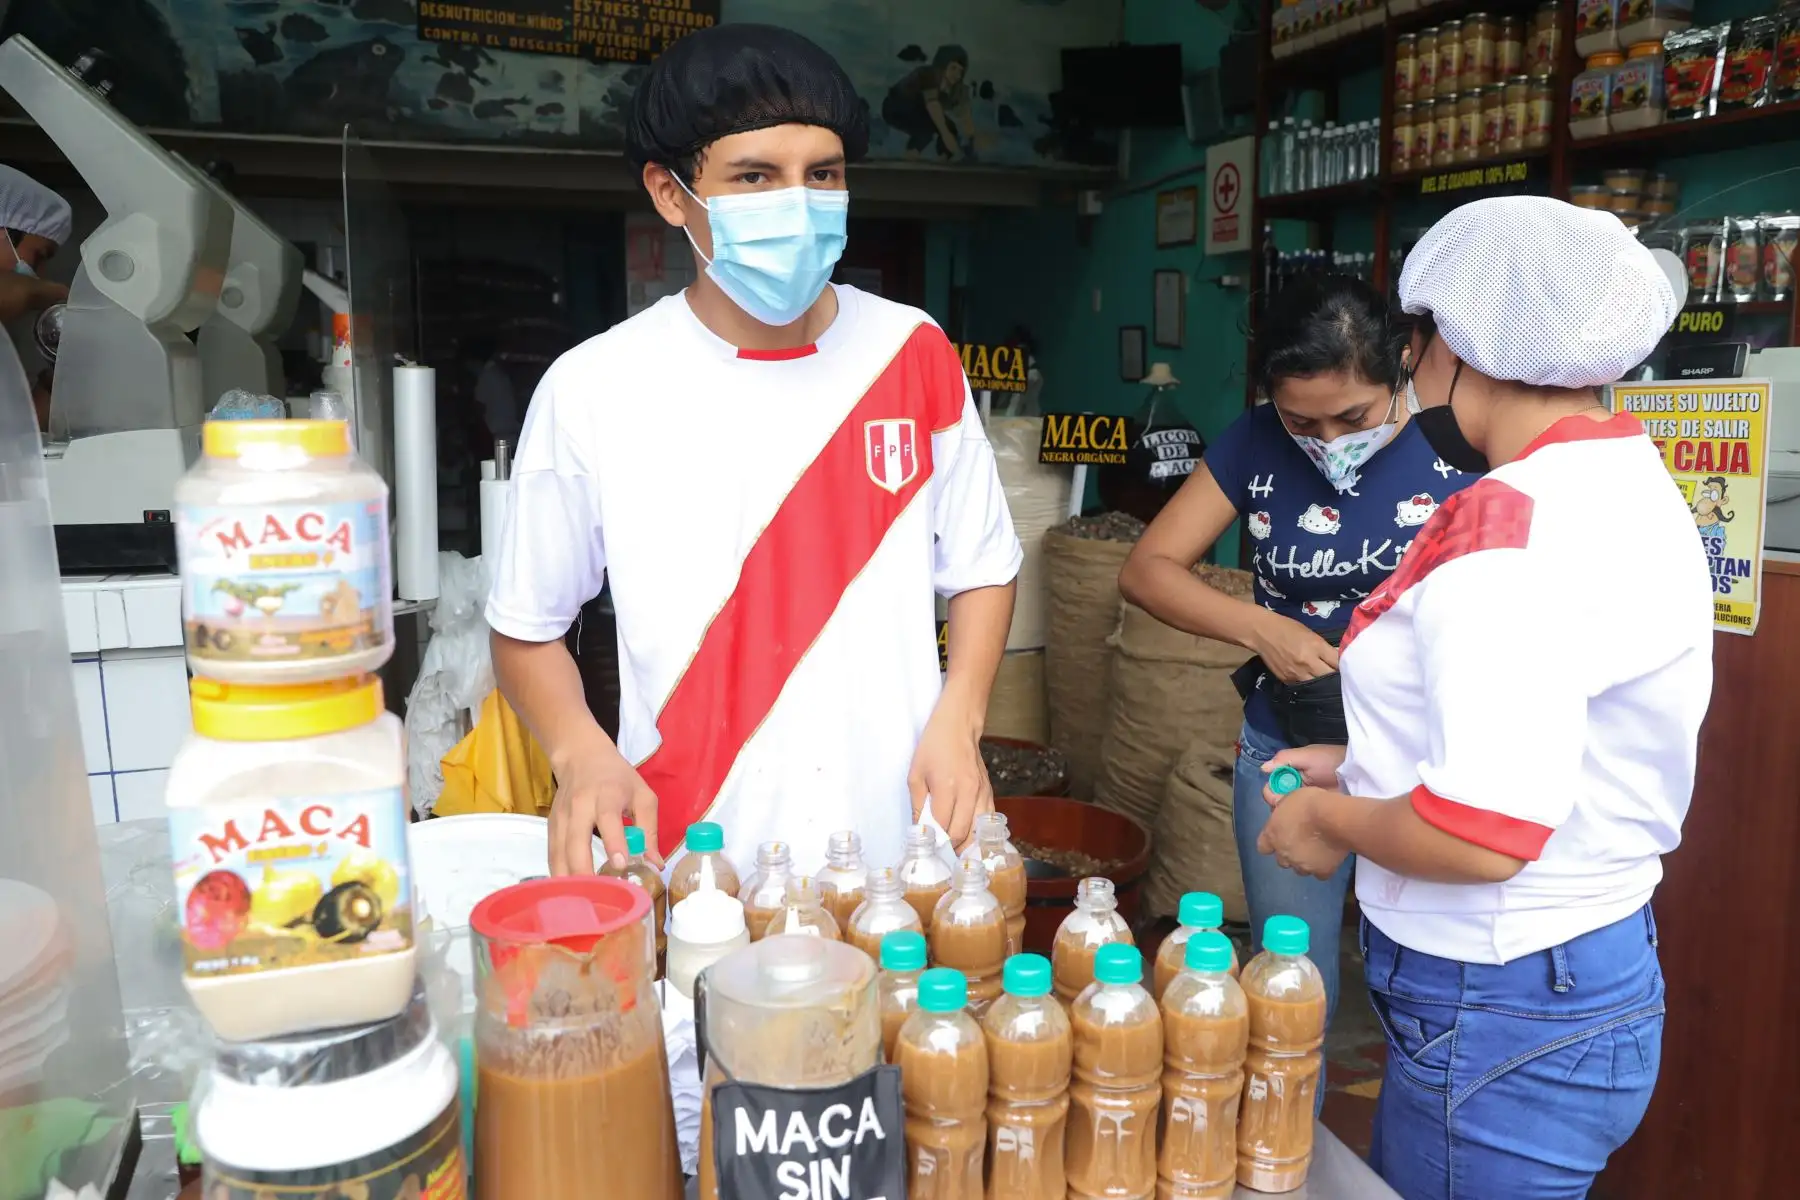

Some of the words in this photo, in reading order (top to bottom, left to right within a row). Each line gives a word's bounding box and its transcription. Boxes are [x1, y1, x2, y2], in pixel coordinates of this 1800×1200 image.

[573, 12, 617, 31] FALTA
[424, 27, 480, 44] CONTRA
[1679, 311, 1724, 333] PURO
[1681, 367, 1714, 376] SHARP
[1624, 393, 1675, 412] REVISE
[1677, 393, 1699, 412] SU
[1702, 392, 1761, 412] VUELTO
[1042, 414, 1128, 450] MACA
[1681, 420, 1701, 438] DE
[1703, 420, 1750, 439] SALIR
[1041, 452, 1075, 463] NEGRA
[1162, 444, 1187, 458] DE
[1674, 440, 1751, 474] CAJA
[216, 512, 352, 559] MACA
[1266, 545, 1358, 579] Hello
[1713, 602, 1732, 612] ERIA
[198, 805, 372, 863] MACA
[734, 1096, 886, 1156] MACA
[776, 1154, 852, 1200] SIN
